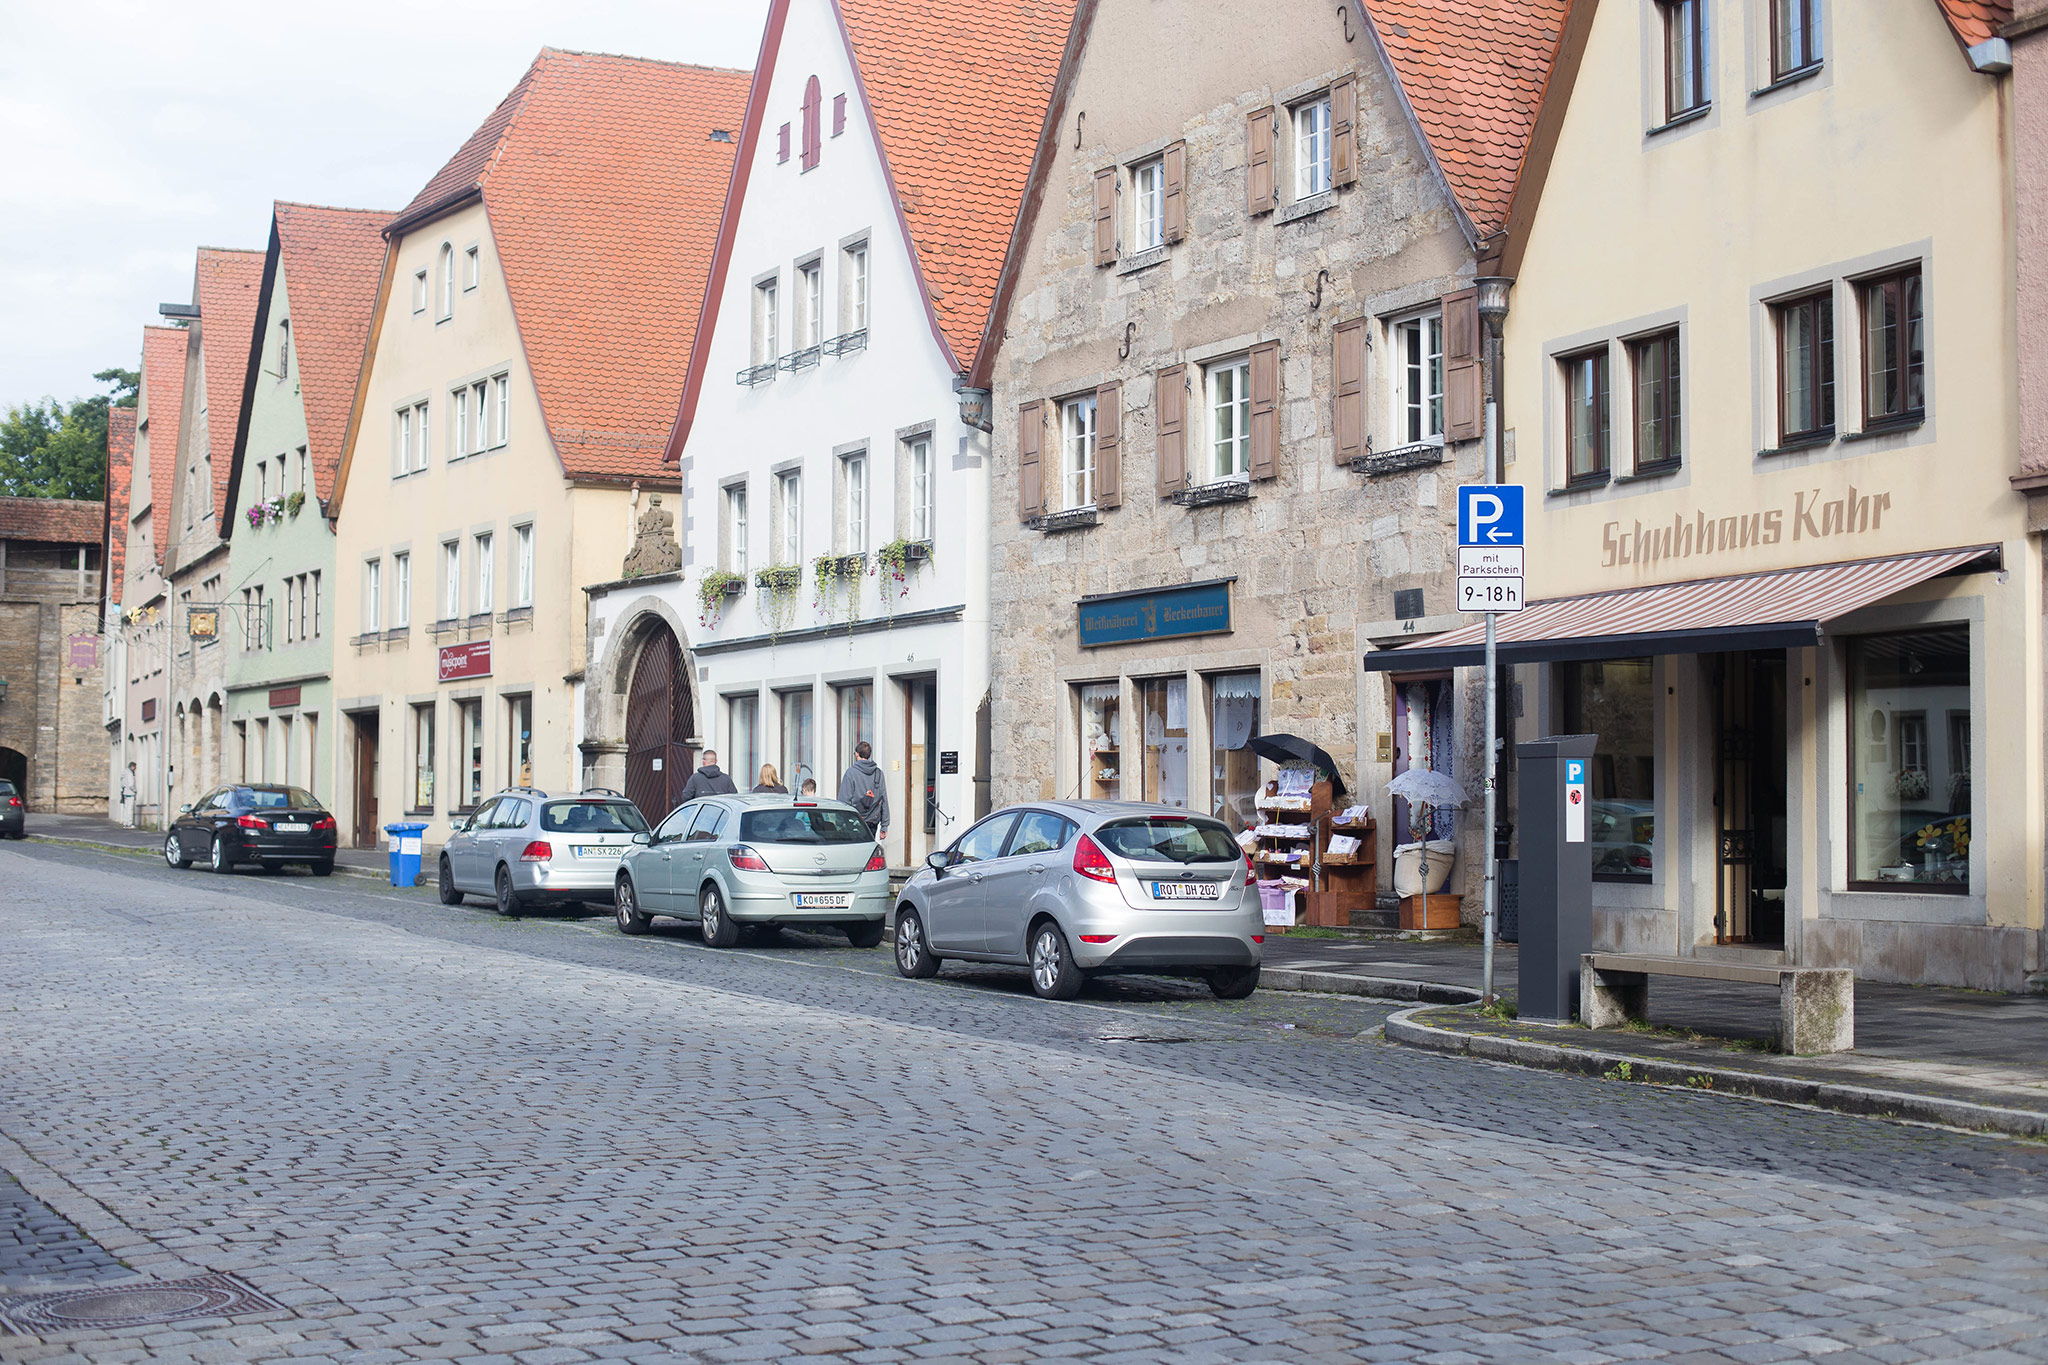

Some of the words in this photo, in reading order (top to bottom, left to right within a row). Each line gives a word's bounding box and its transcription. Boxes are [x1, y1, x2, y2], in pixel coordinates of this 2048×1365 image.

[1469, 494, 1504, 543] P
[1602, 509, 1783, 567] Schuhhaus
[1793, 484, 1891, 541] Kahr
[1483, 554, 1499, 562] mit
[1463, 565, 1519, 574] Parkschein
[1085, 612, 1138, 631] Weißnäherei
[1163, 604, 1224, 622] Beckenbauer
[1403, 620, 1415, 633] 44
[1569, 763, 1582, 781] P
[583, 847, 593, 855] AN
[597, 847, 607, 855] SX
[608, 847, 622, 855] 226
[1160, 884, 1178, 896] ROT
[1185, 884, 1198, 896] DH
[1199, 884, 1217, 896] 202
